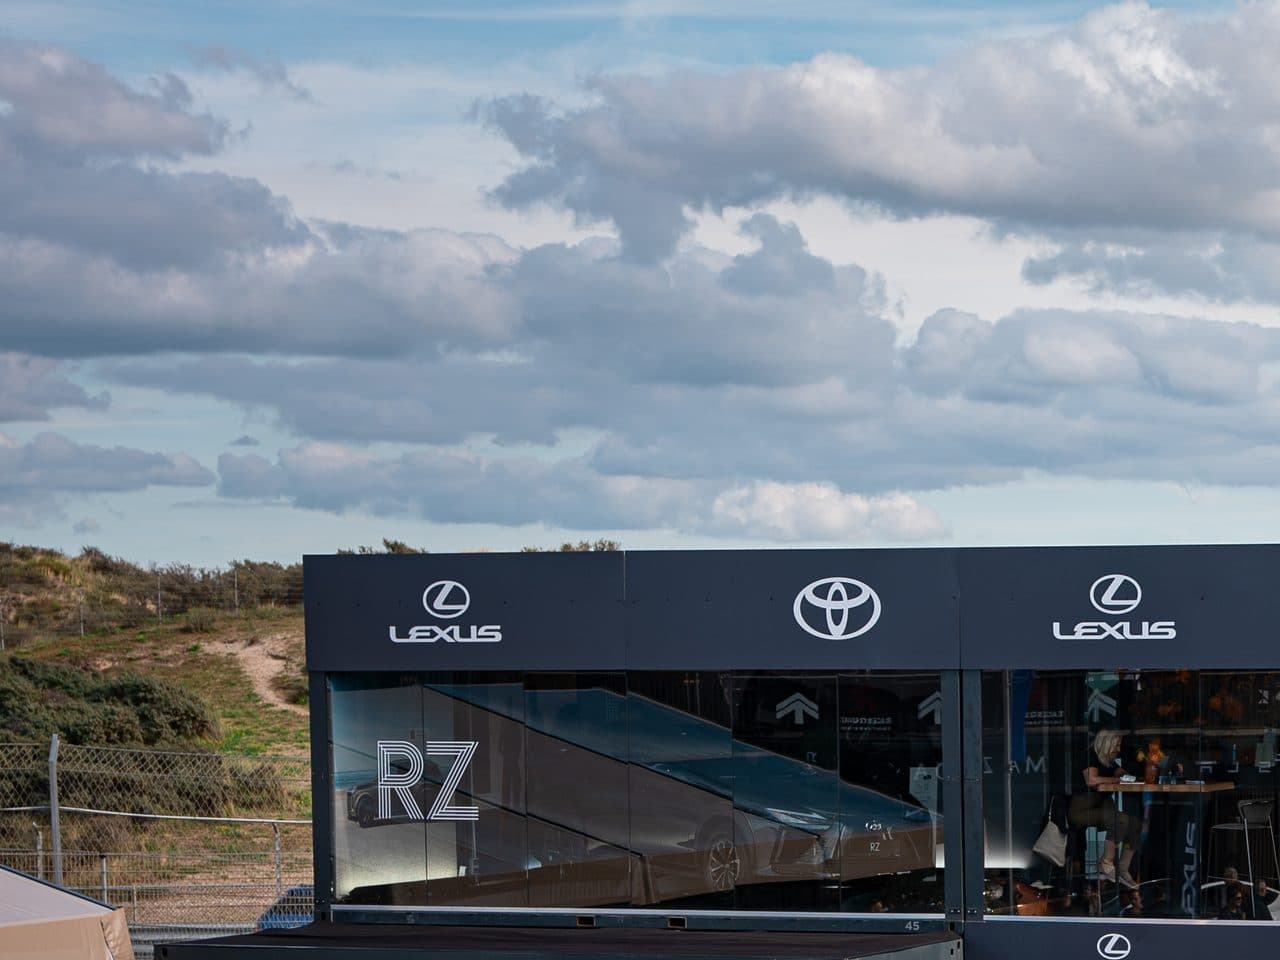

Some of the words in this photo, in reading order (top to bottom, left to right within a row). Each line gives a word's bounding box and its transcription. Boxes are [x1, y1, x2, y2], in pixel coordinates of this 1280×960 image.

[389, 625, 502, 643] LEXUS
[1052, 621, 1177, 640] LEXUS
[377, 740, 479, 820] RZ
[870, 841, 881, 852] RZ
[904, 921, 920, 931] 45
